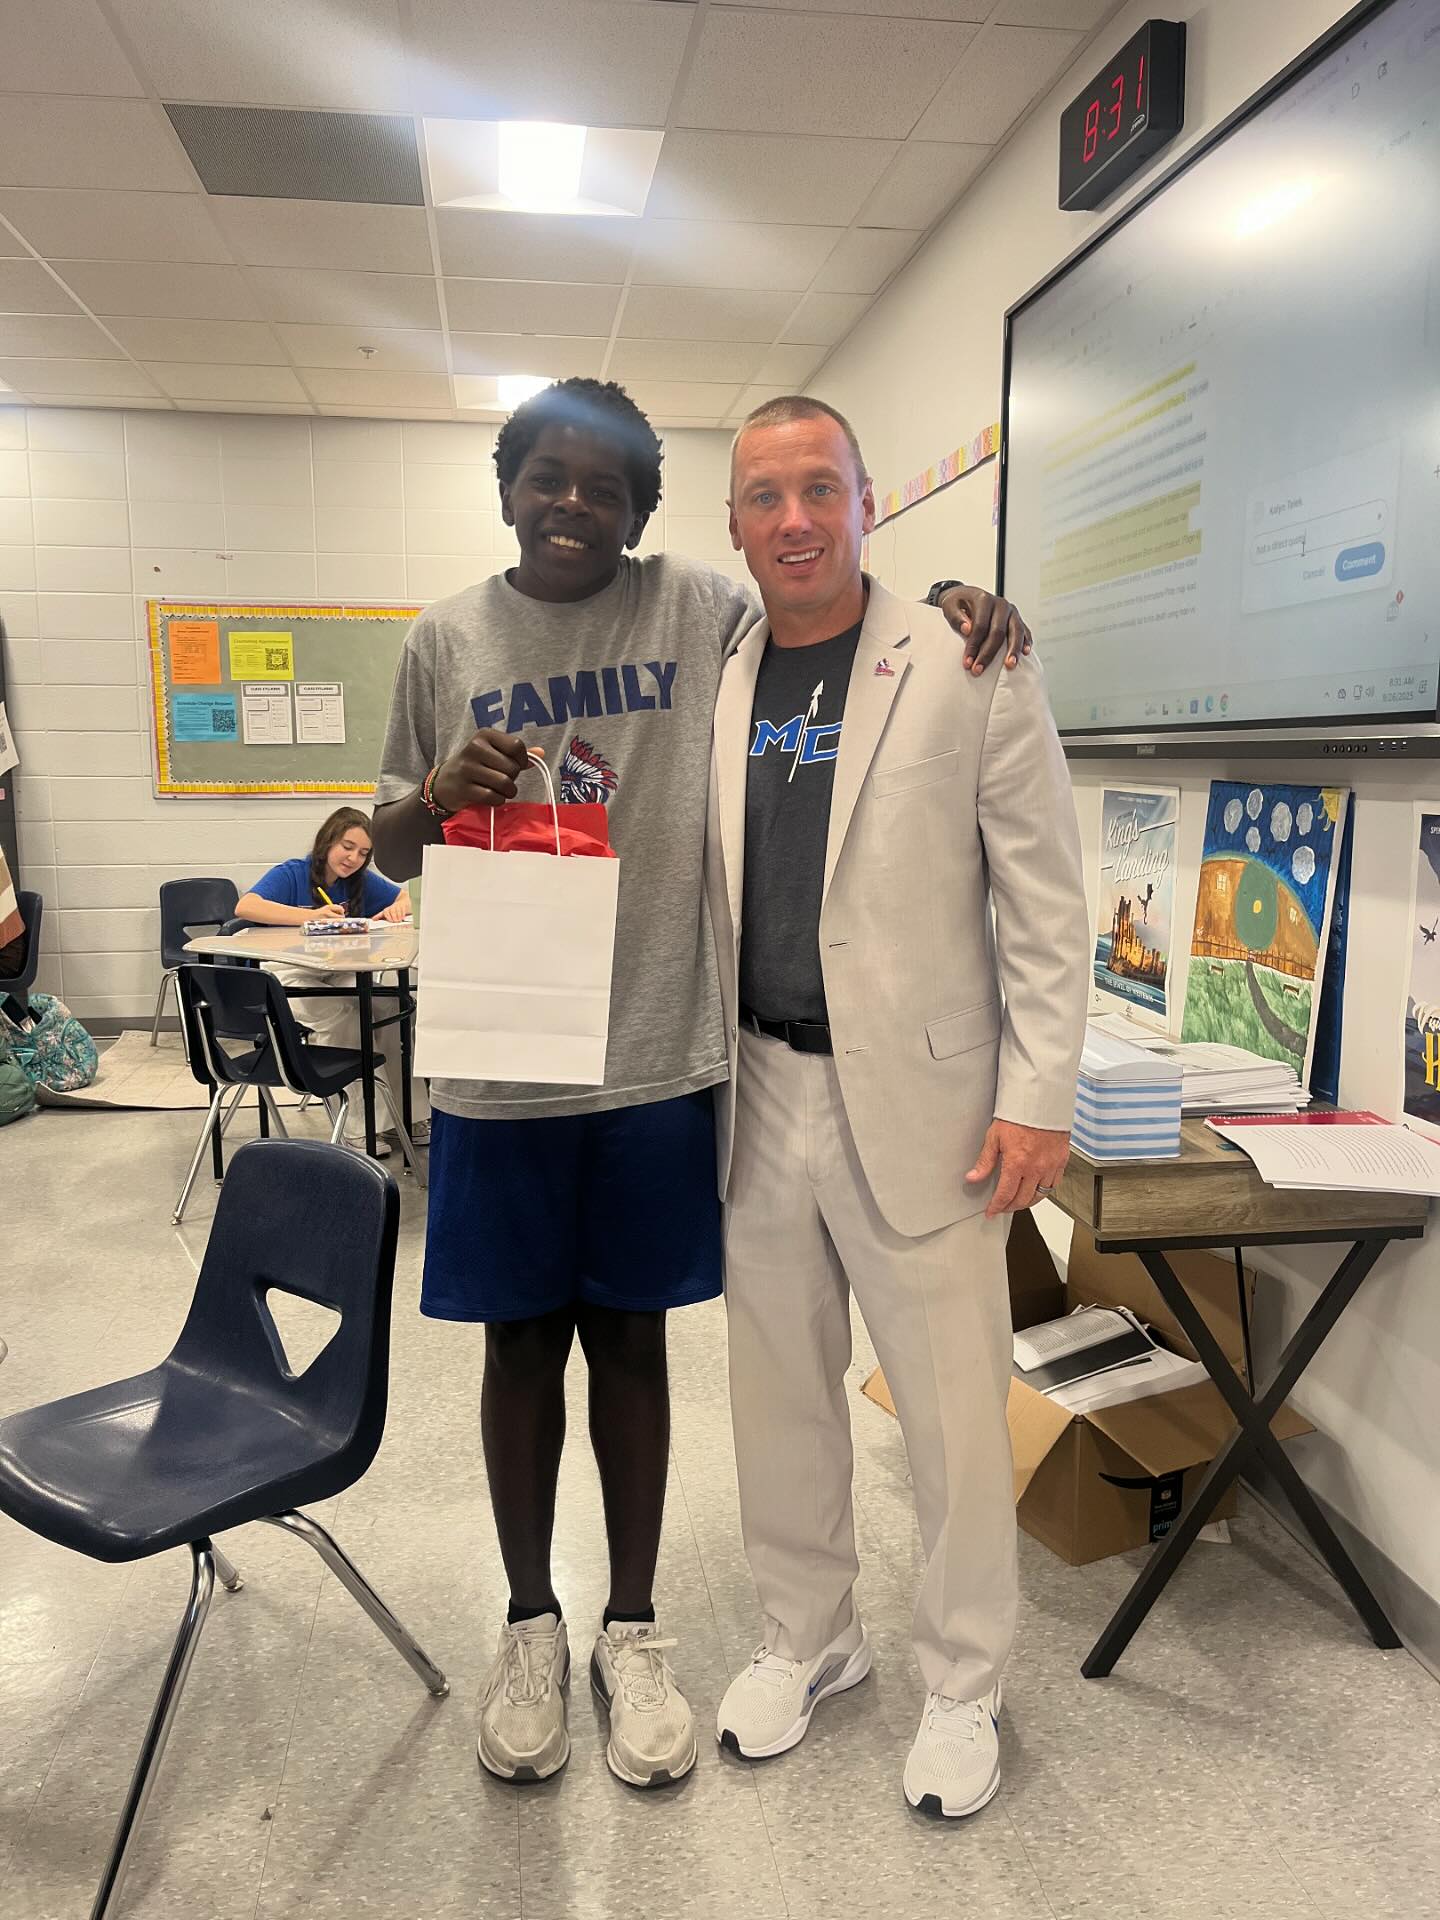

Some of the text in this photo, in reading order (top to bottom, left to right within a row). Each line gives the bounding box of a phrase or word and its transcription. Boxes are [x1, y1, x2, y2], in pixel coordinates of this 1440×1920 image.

[1083, 55, 1144, 163] 8:31
[1342, 554, 1377, 571] Comment
[470, 661, 678, 733] FAMILY
[1114, 843, 1170, 890] Landing
[1153, 1520, 1174, 1534] prim
